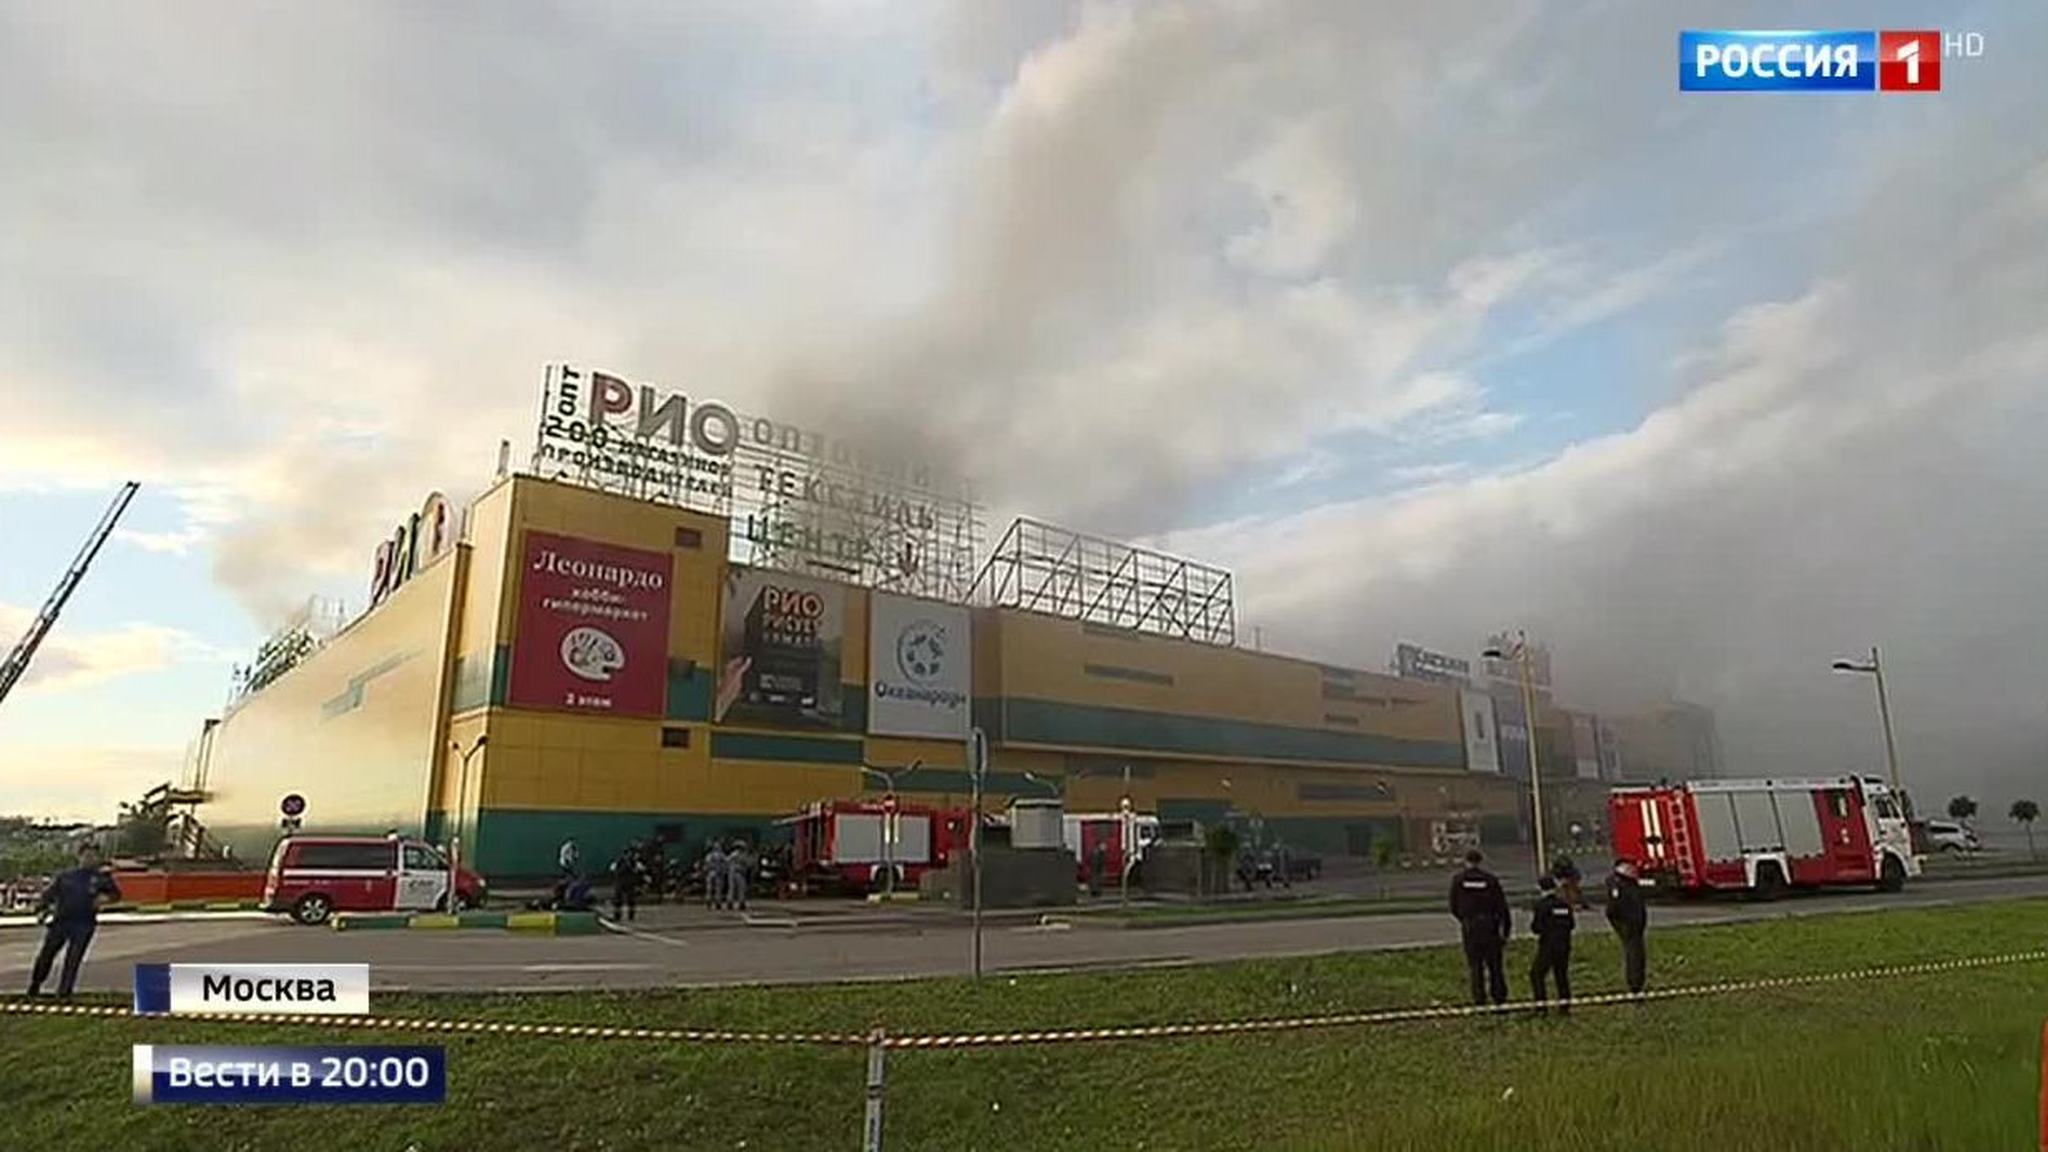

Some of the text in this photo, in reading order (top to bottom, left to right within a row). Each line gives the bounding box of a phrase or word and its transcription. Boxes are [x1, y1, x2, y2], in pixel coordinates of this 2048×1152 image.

[588, 370, 740, 458] РИО
[532, 550, 664, 590] Леонардо
[762, 585, 826, 618] РИО
